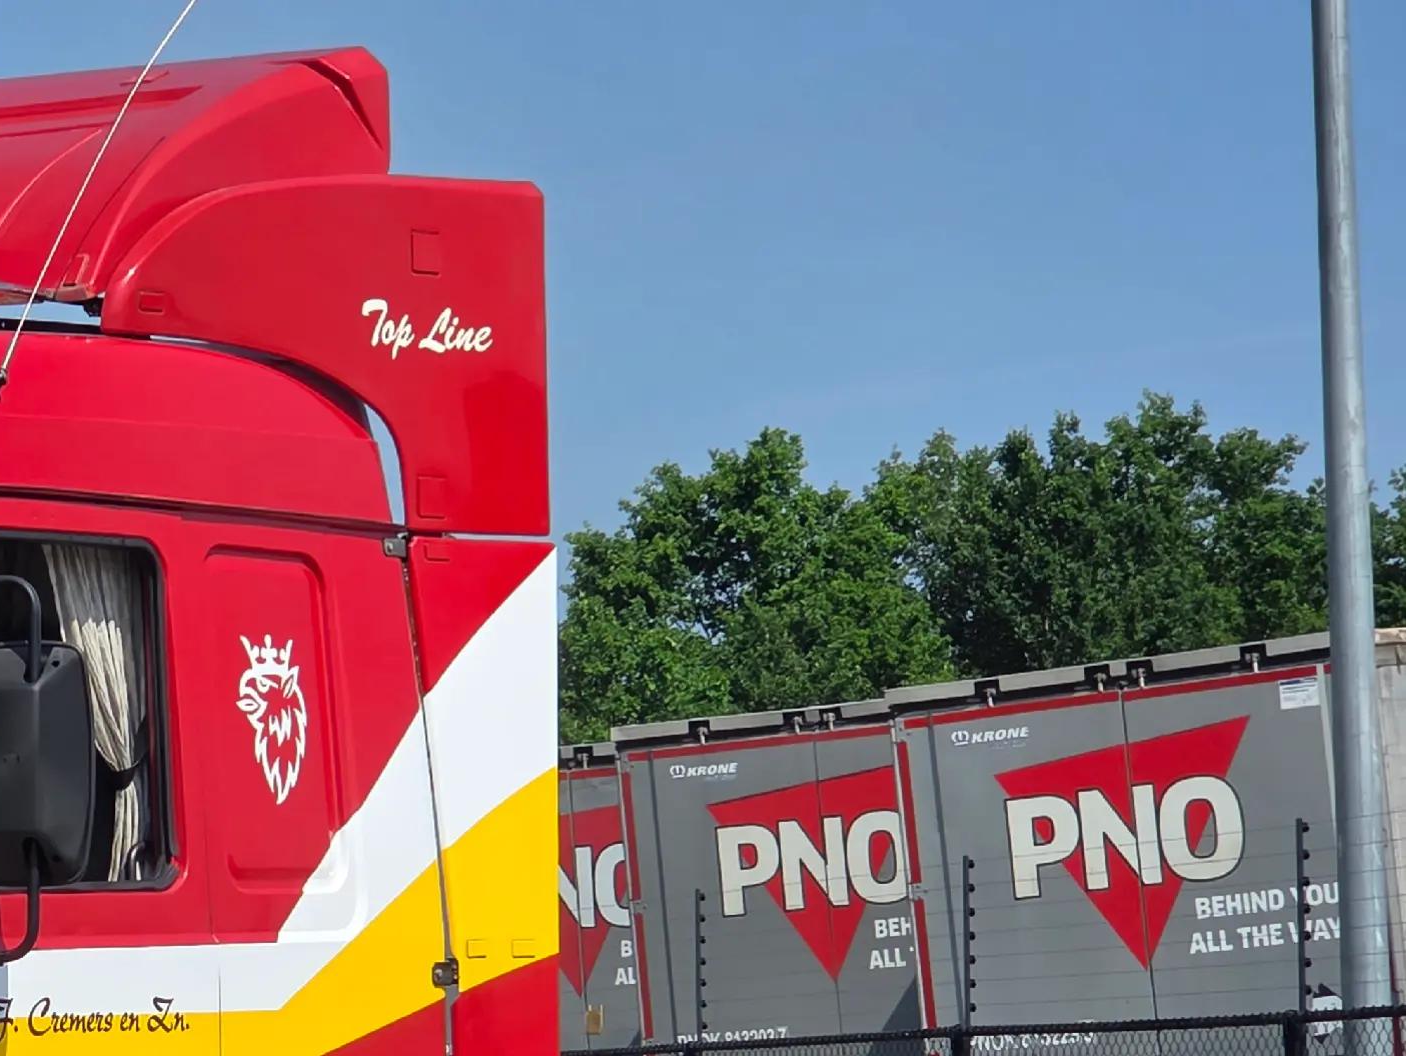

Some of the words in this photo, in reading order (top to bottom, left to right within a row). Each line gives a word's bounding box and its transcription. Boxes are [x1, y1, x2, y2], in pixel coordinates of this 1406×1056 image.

[361, 298, 414, 360] Top
[418, 307, 493, 353] Line
[971, 726, 1030, 744] KRONE
[686, 762, 738, 778] KRONE
[1004, 775, 1245, 901] PNO
[715, 810, 910, 918] PNO
[559, 842, 632, 929] NO
[1194, 888, 1285, 920] BEHIND
[874, 917, 911, 939] BEH
[1189, 930, 1234, 955] ALL
[1236, 923, 1284, 949] THE
[869, 948, 906, 970] ALL
[615, 966, 637, 986] AL
[28, 997, 114, 1038] Cremers
[120, 1012, 142, 1033] en
[147, 997, 191, 1034] Zn.
